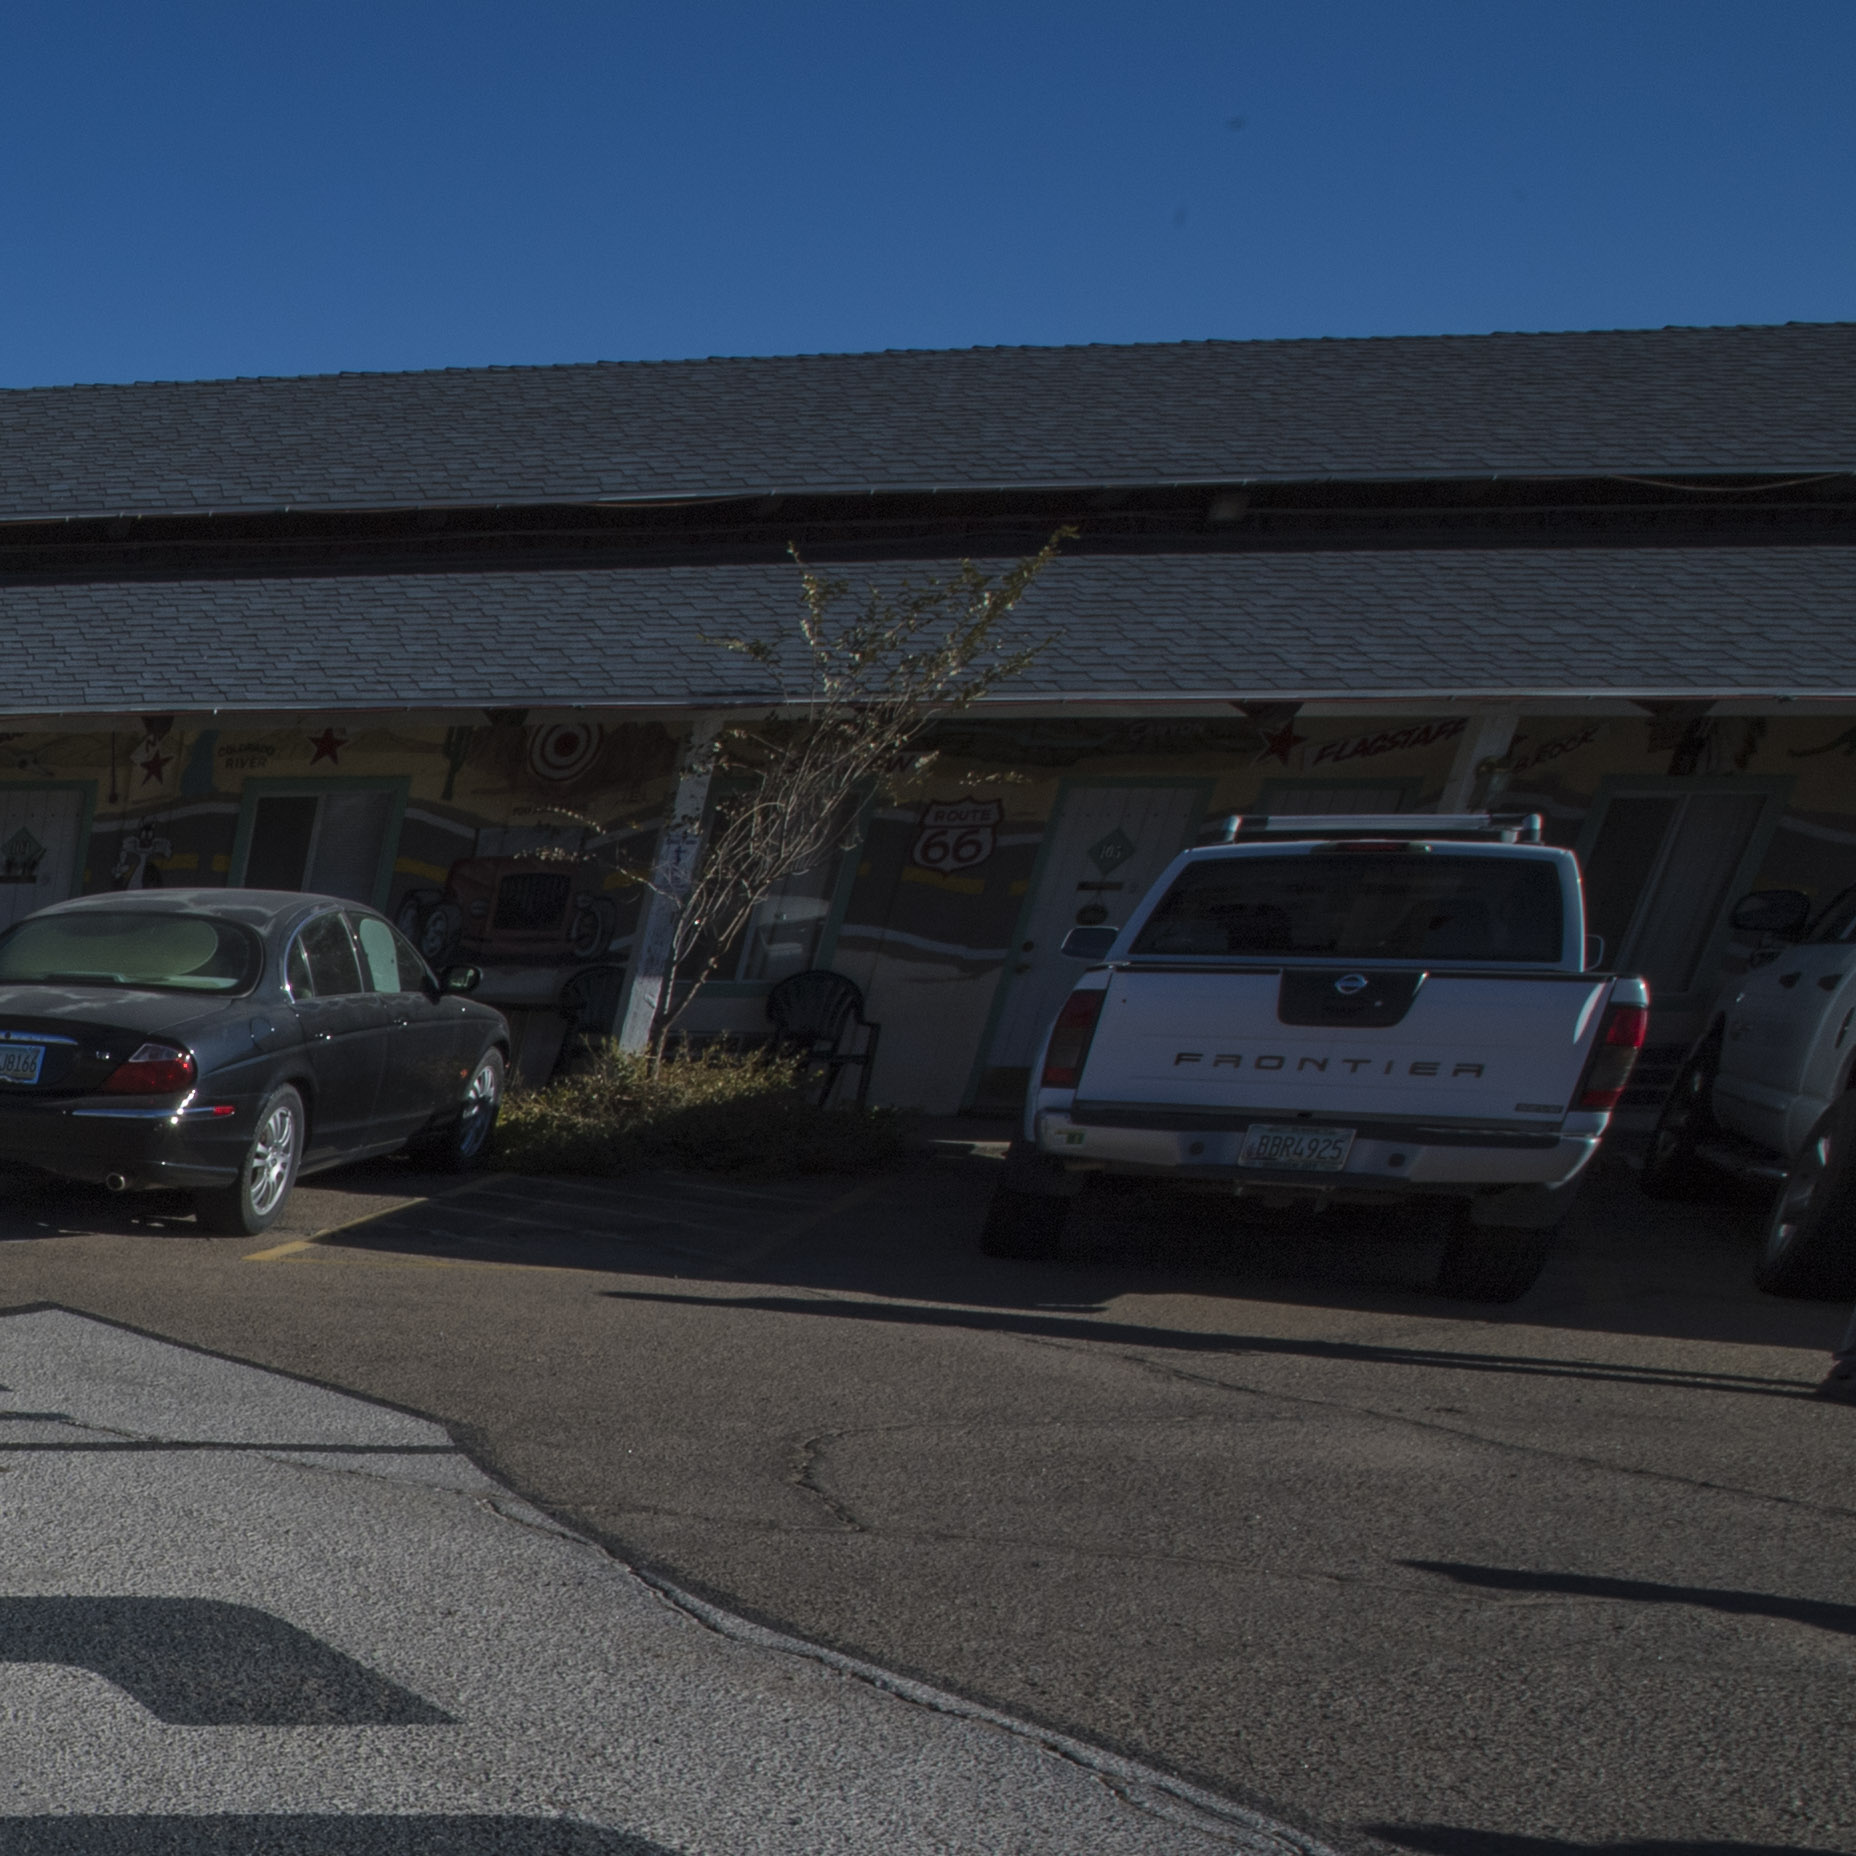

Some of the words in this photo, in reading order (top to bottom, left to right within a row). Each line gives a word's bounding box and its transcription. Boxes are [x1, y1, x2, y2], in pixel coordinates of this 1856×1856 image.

[225, 759, 269, 769] RIVER
[934, 808, 992, 823] ROUTE
[920, 829, 983, 865] 66
[1174, 1052, 1485, 1079] FRONTIER
[1255, 1135, 1345, 1161] BBR4925
